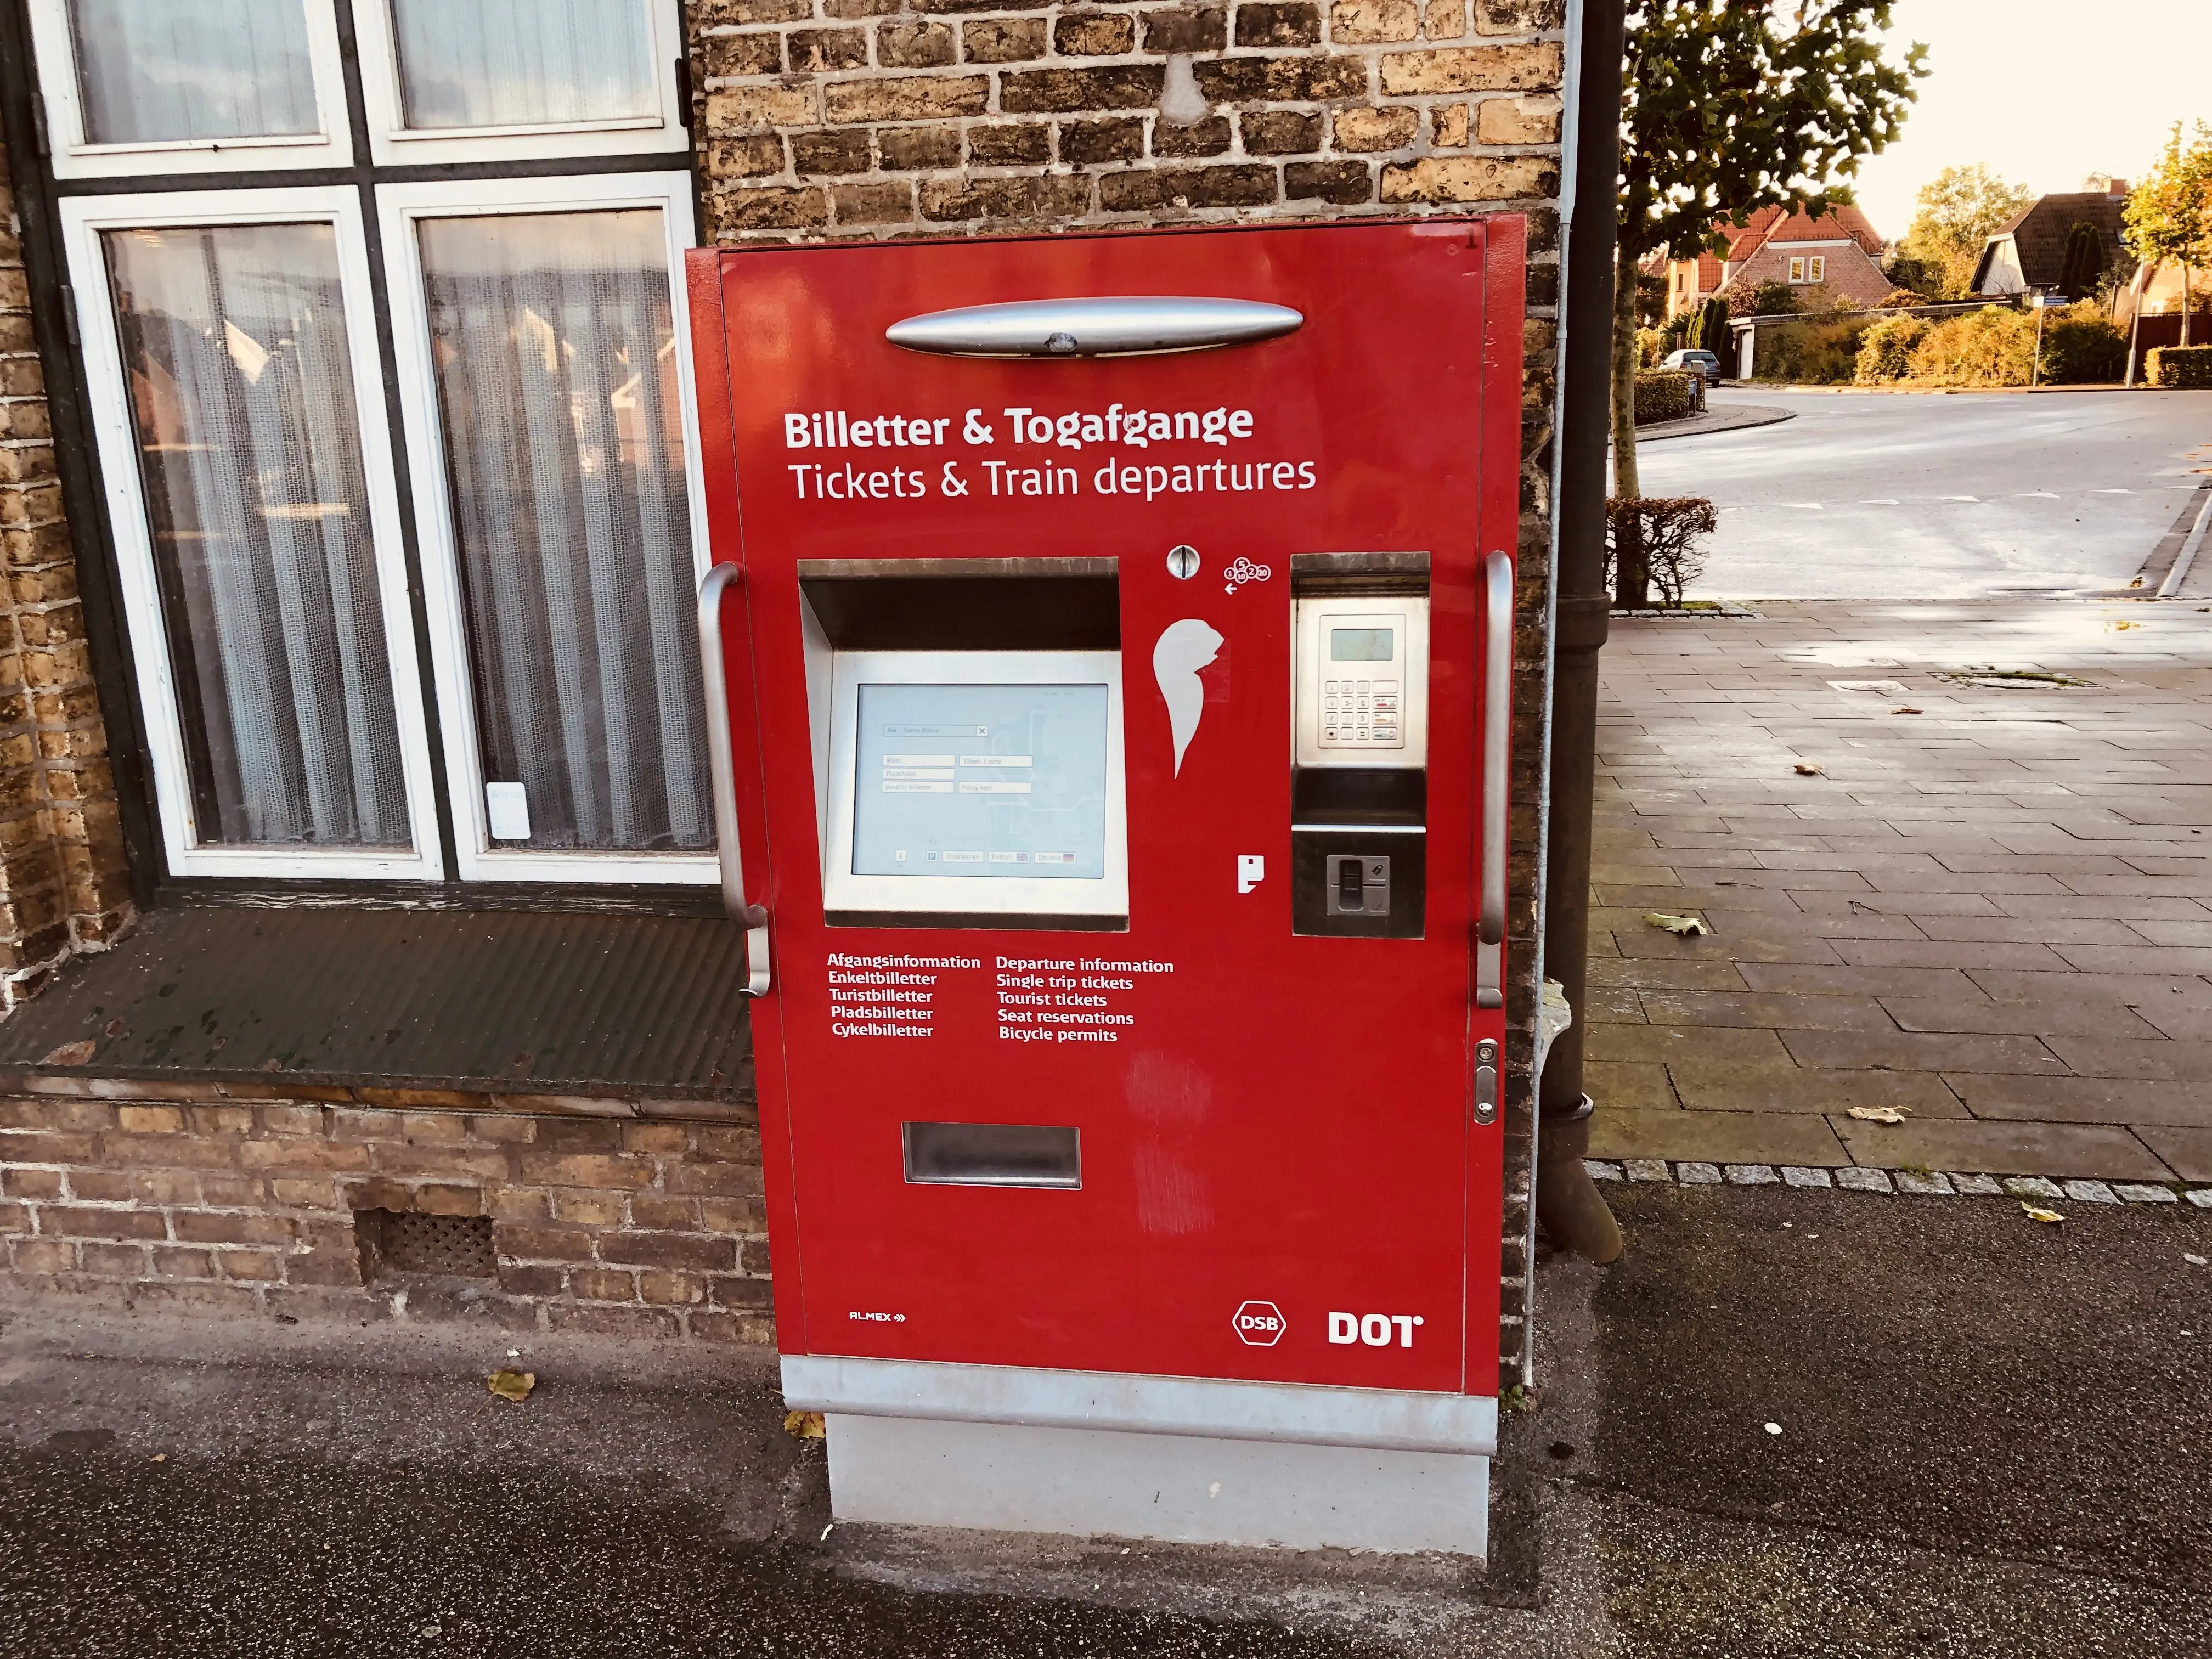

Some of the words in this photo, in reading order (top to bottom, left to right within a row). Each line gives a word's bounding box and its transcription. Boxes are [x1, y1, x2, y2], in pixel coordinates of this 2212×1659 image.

[785, 411, 950, 448] Billetter
[963, 409, 994, 444] &
[1004, 404, 1253, 450] Togafgange
[788, 463, 926, 498] Tickets
[941, 461, 968, 496] &
[981, 459, 1077, 495] Train
[1094, 457, 1316, 501] departures
[1238, 561, 1245, 570] 5
[827, 953, 980, 969] Afgangsinformation
[996, 956, 1075, 972] Departure
[1080, 958, 1173, 972] information
[829, 971, 937, 985] Enkeltbilletter
[997, 974, 1044, 989] Single
[1048, 975, 1076, 991] trip
[1081, 976, 1133, 989] tickets
[829, 989, 933, 1002] Turistbilletter
[997, 992, 1051, 1005] Tourist
[1055, 993, 1107, 1006] tickets
[831, 1006, 933, 1019] Pladsbilletter
[998, 1009, 1032, 1022] Seat
[1037, 1012, 1133, 1024] reservations
[832, 1023, 933, 1037] Cykelbilletter
[1000, 1026, 1053, 1042] Bicycle
[1058, 1029, 1117, 1043] permits
[850, 1312, 891, 1321] ALMEX
[1241, 1316, 1278, 1330] DSB
[1329, 1312, 1420, 1347] DOT
